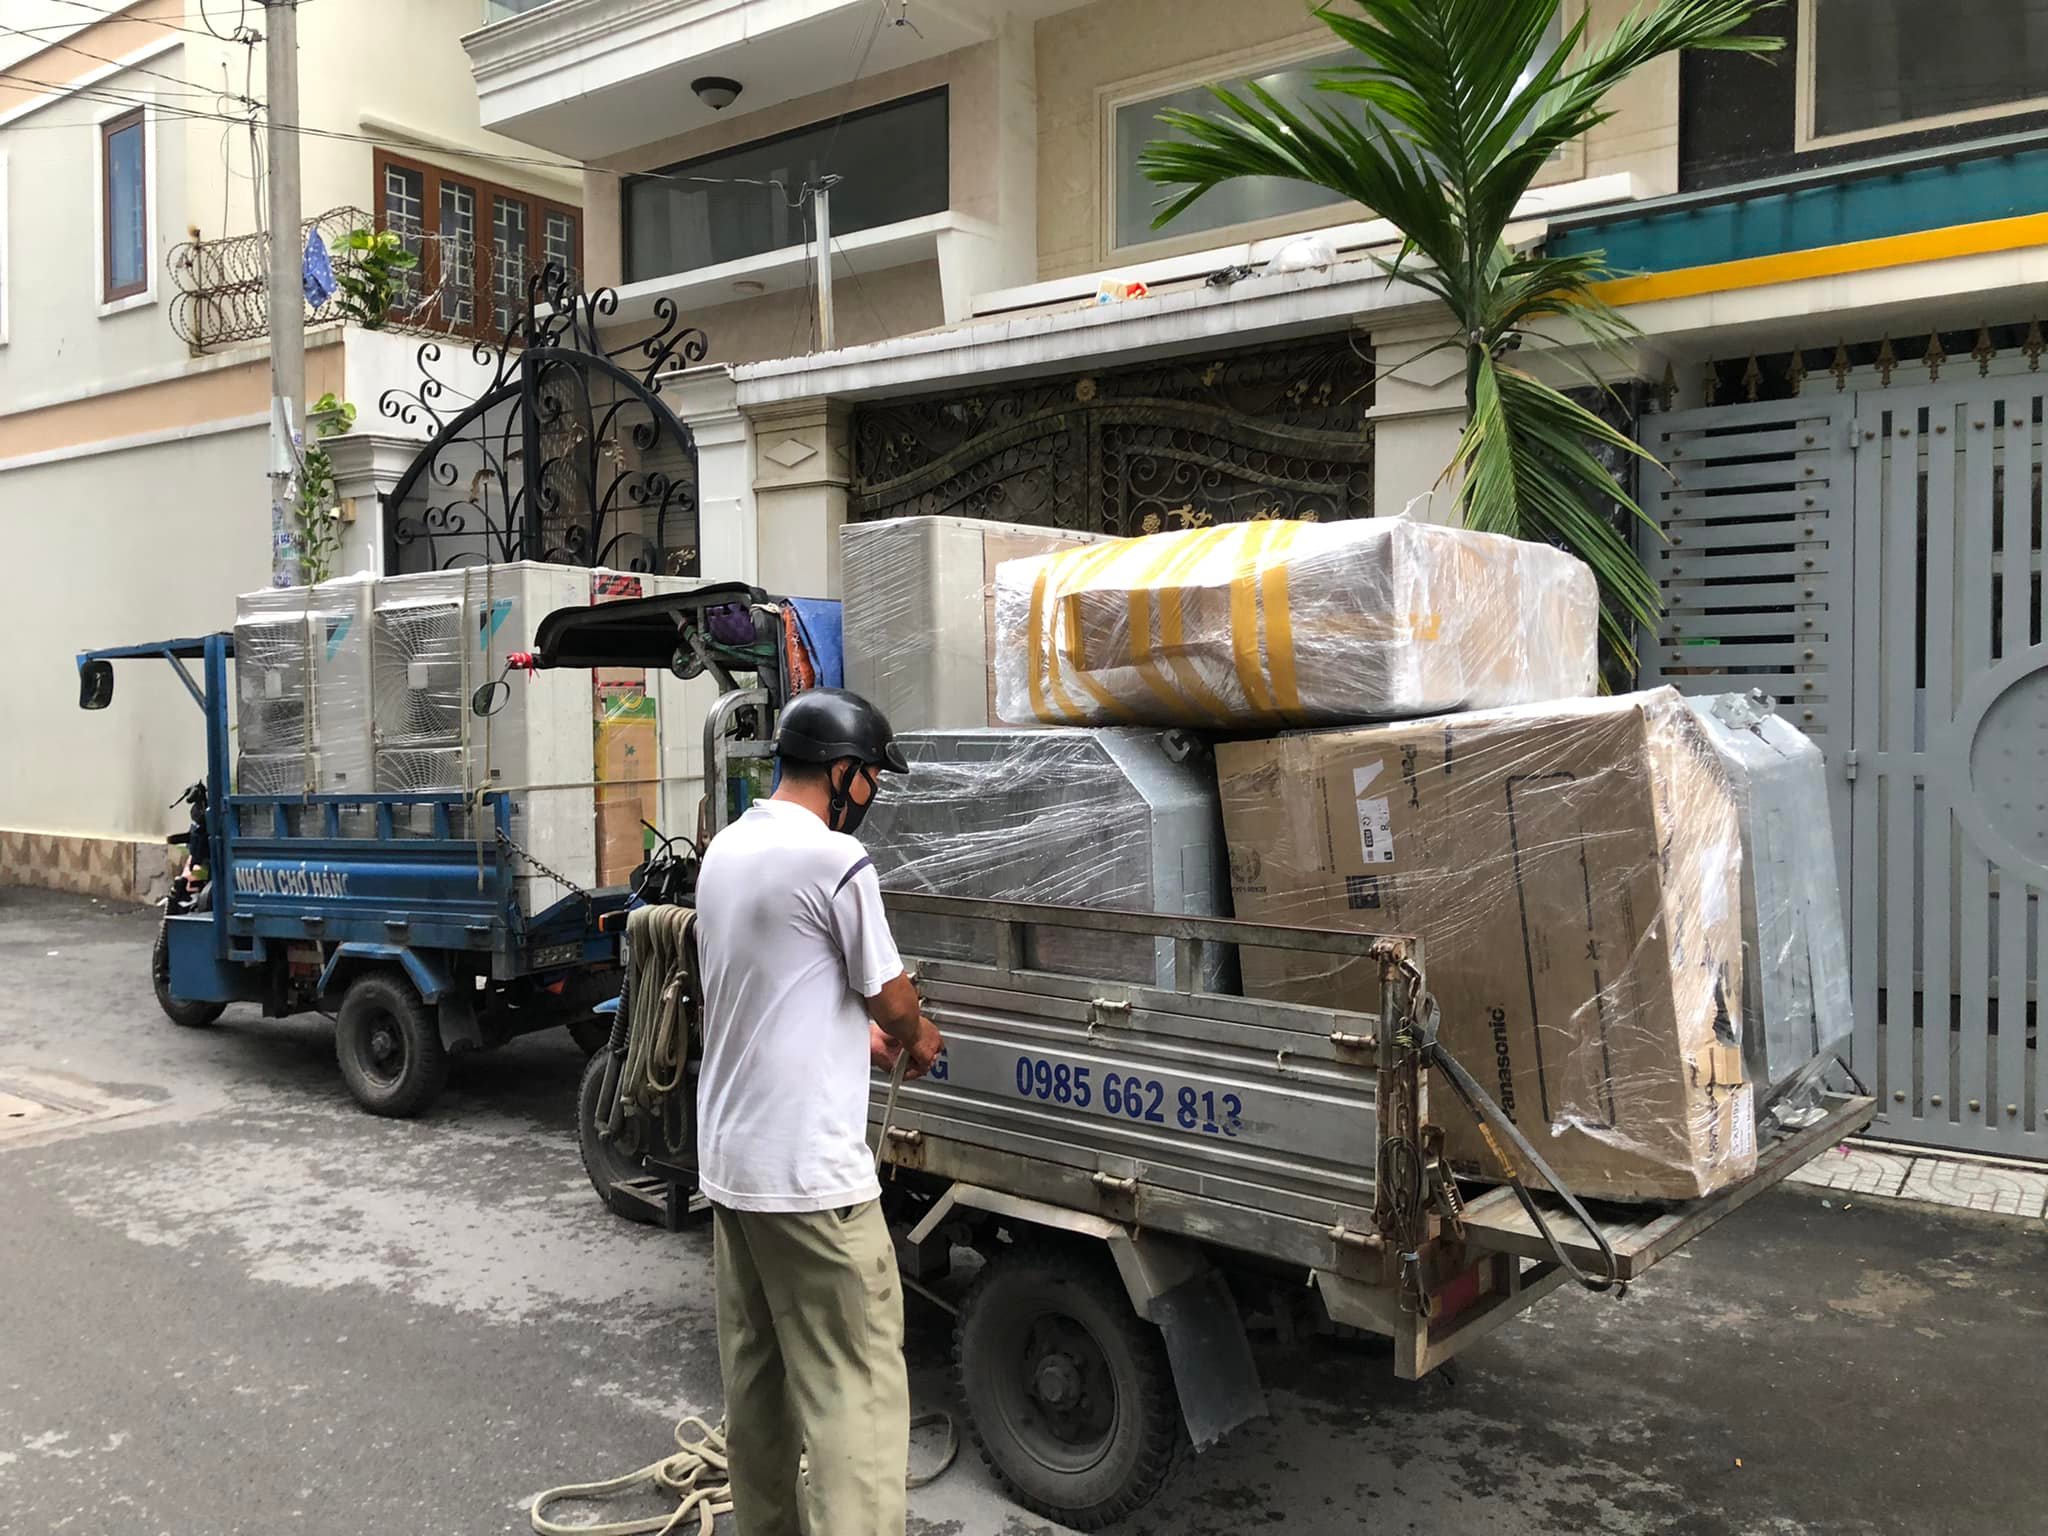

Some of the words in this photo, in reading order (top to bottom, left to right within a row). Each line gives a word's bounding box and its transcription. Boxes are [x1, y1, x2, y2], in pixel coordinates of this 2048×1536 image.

[1016, 1056, 1091, 1107] 0985
[1103, 1073, 1164, 1123] 662
[1178, 1086, 1245, 1137] 813
